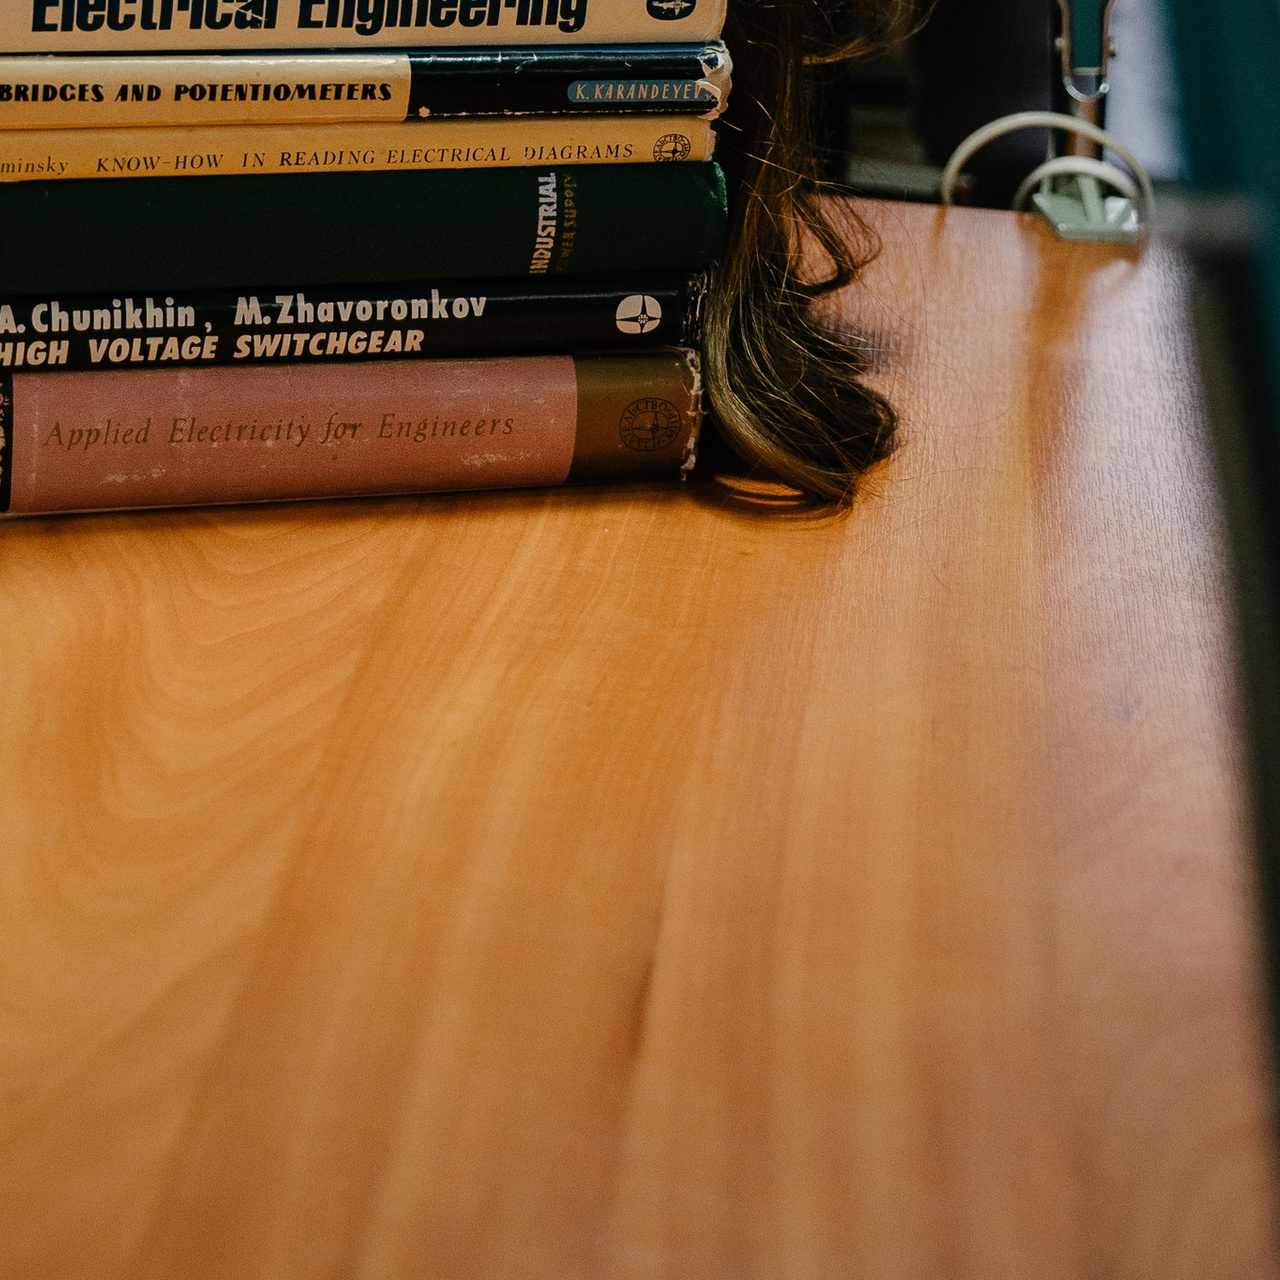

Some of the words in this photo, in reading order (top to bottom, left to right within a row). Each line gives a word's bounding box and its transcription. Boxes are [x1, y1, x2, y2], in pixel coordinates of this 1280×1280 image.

[114, 83, 162, 102] AND
[173, 82, 393, 102] POTENTIOMETERS
[95, 153, 224, 173] KNOW-HOW
[241, 151, 267, 168] IN
[278, 149, 376, 167] READING
[386, 146, 512, 165] ELECTRICAL
[524, 142, 634, 161] DIAGRAMS
[529, 172, 558, 275] INDUSTRIAL
[88, 335, 219, 363] VOLTAGE
[233, 329, 425, 359] SWITCHGEAR
[41, 417, 153, 450] Applied
[166, 417, 311, 448] Electricity
[319, 411, 363, 444] for
[378, 413, 515, 443] Engineers
